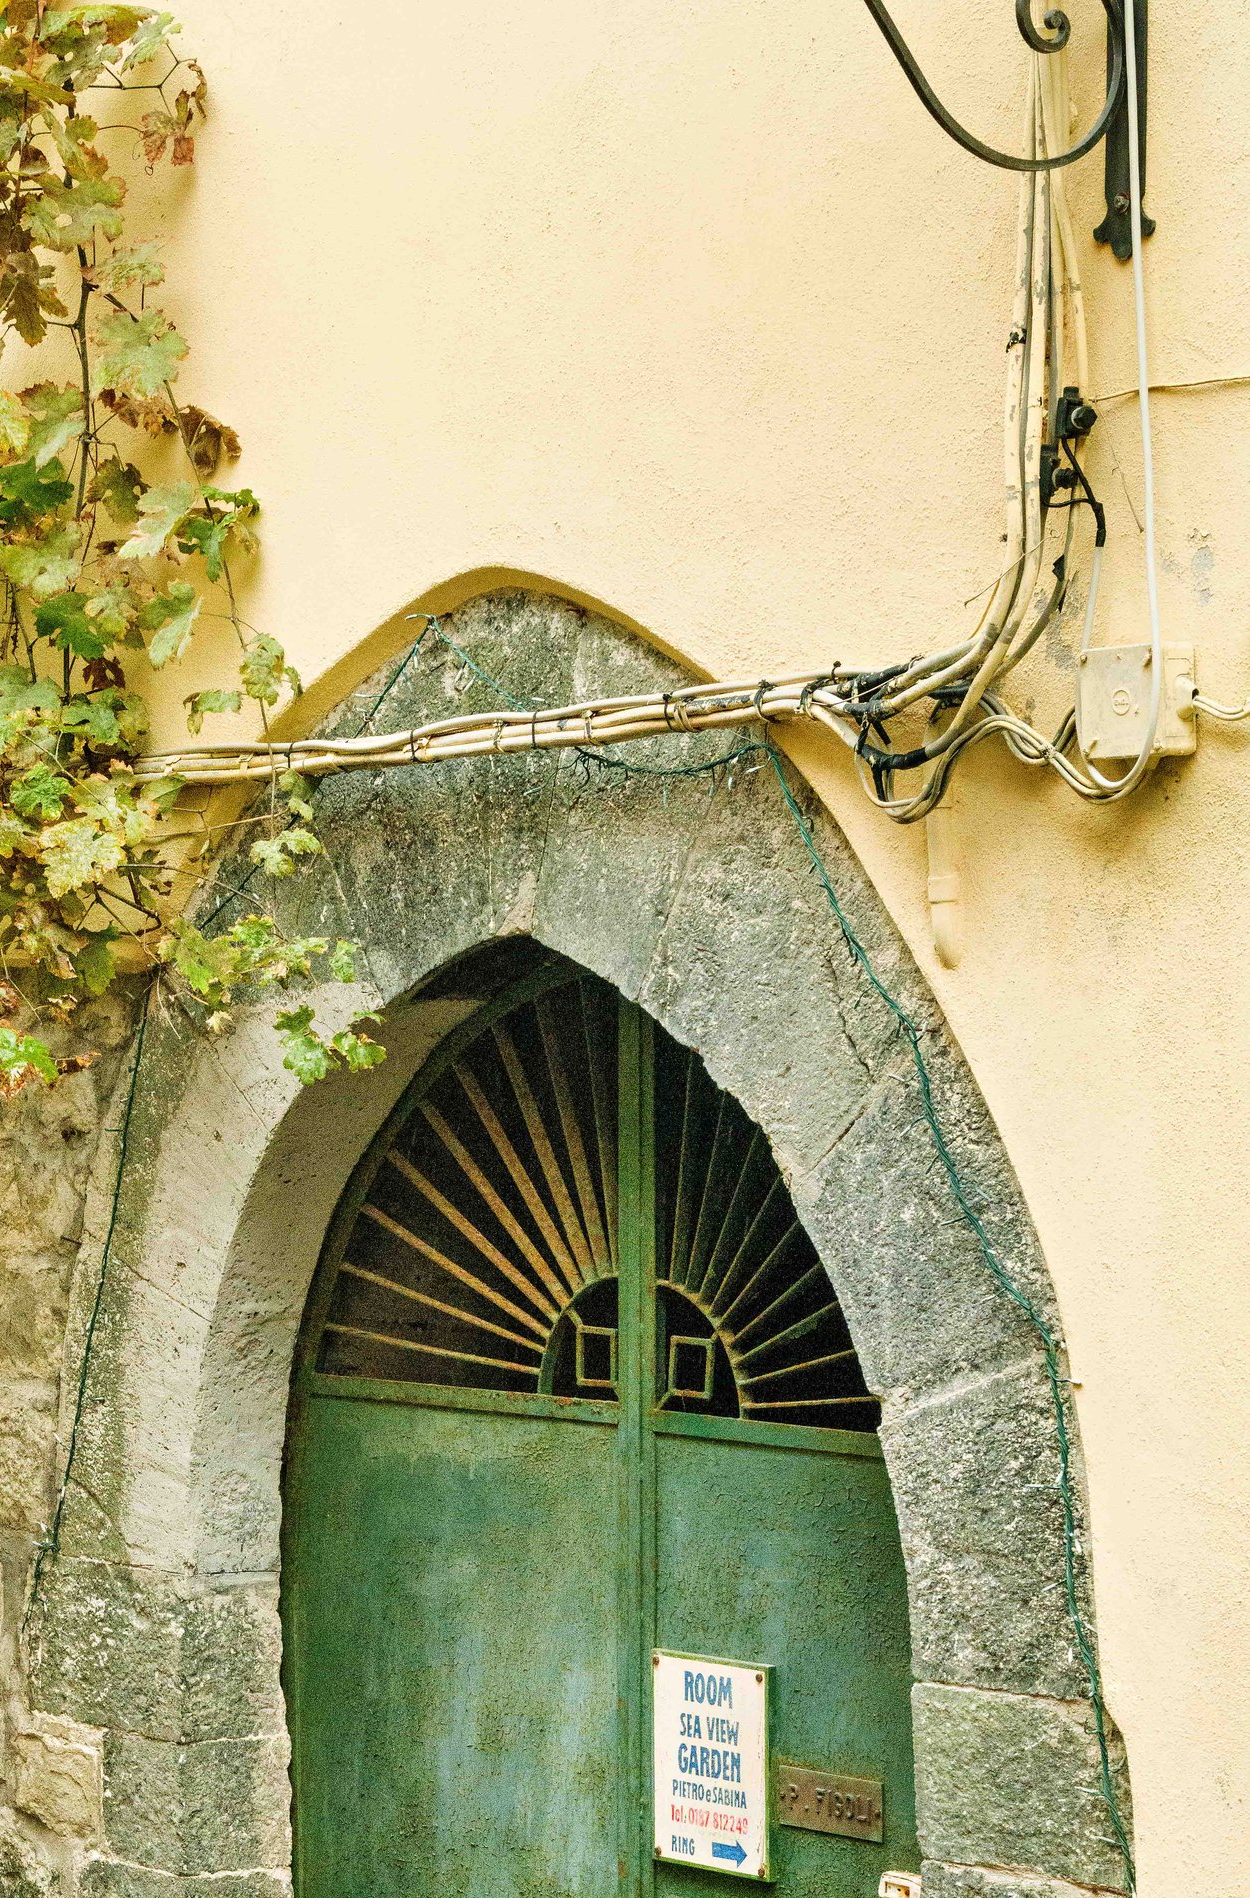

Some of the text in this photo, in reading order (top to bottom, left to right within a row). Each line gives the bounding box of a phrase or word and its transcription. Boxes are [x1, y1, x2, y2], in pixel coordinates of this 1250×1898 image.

[684, 1670, 733, 1709] ROOM
[680, 1713, 739, 1746] SEA VIEW
[678, 1743, 741, 1783] GARDEN
[672, 1779, 705, 1801] PIETRO
[712, 1786, 747, 1809] SABINA
[713, 1811, 749, 1835] 812249
[671, 1835, 695, 1856] RING
